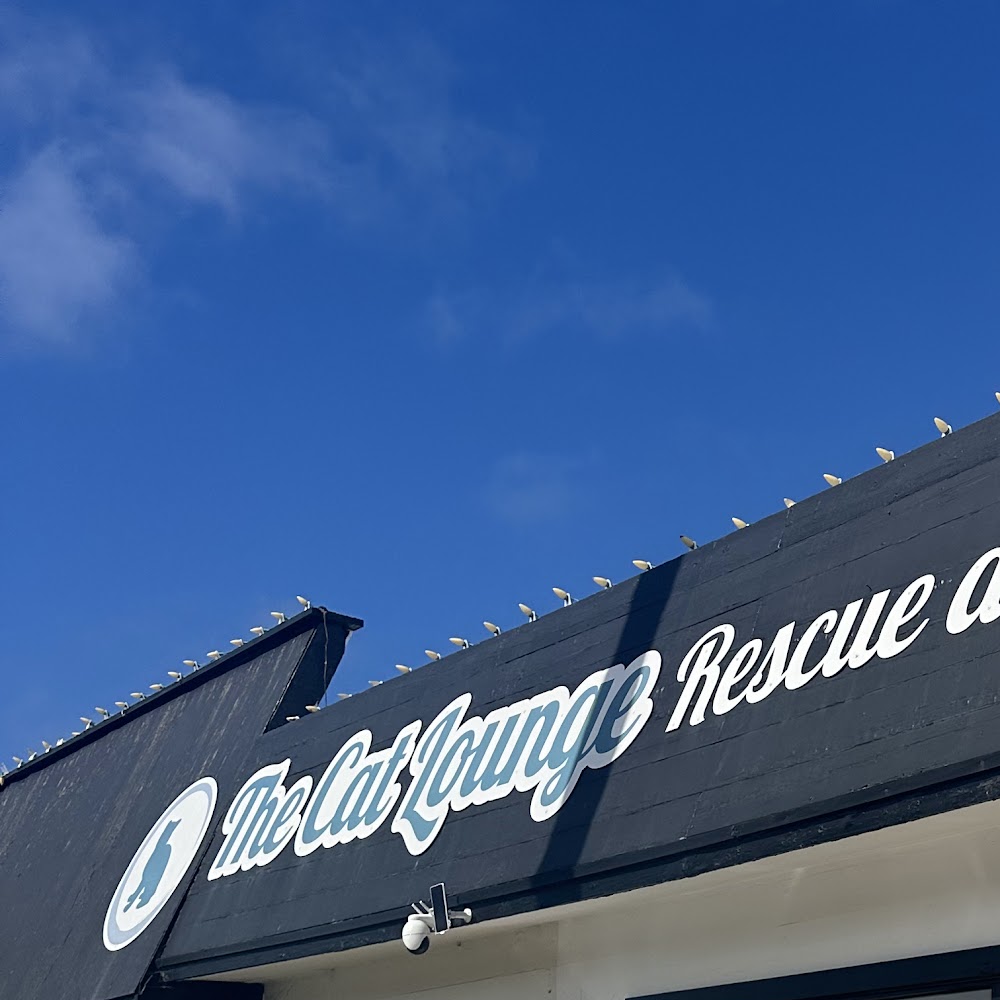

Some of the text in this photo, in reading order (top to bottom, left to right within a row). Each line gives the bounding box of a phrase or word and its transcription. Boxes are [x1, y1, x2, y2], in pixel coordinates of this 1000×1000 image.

[209, 765, 308, 876] The
[298, 728, 416, 852] Cat
[395, 655, 657, 851] Lounge
[665, 573, 934, 732] Rescue
